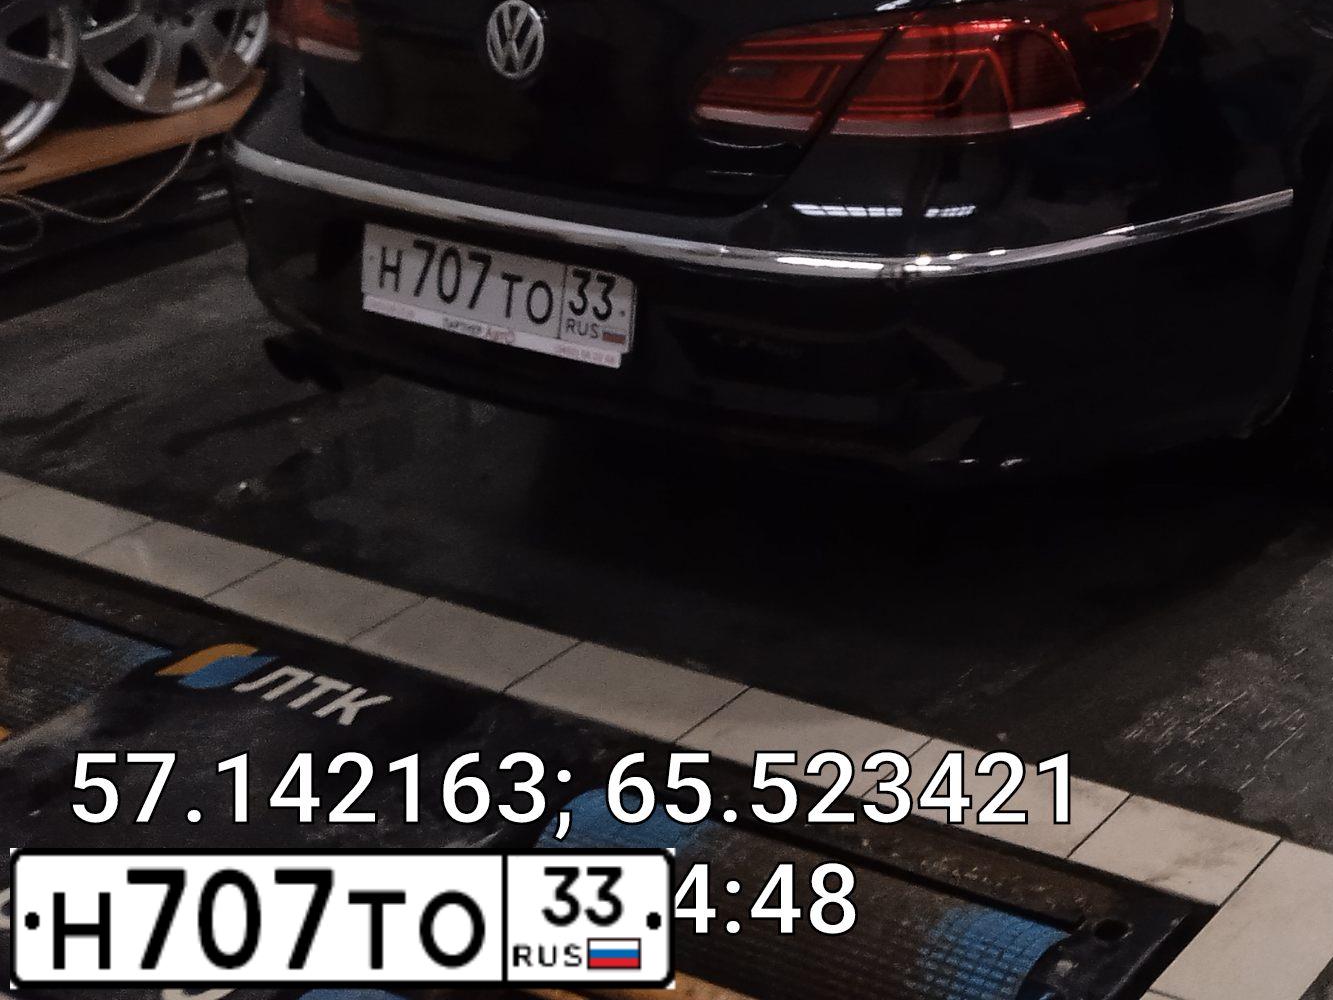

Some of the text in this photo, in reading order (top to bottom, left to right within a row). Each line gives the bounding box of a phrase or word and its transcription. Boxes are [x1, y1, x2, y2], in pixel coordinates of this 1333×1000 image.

[568, 267, 616, 321] 33
[565, 319, 599, 339] RUS
[232, 665, 393, 726] ЛТК
